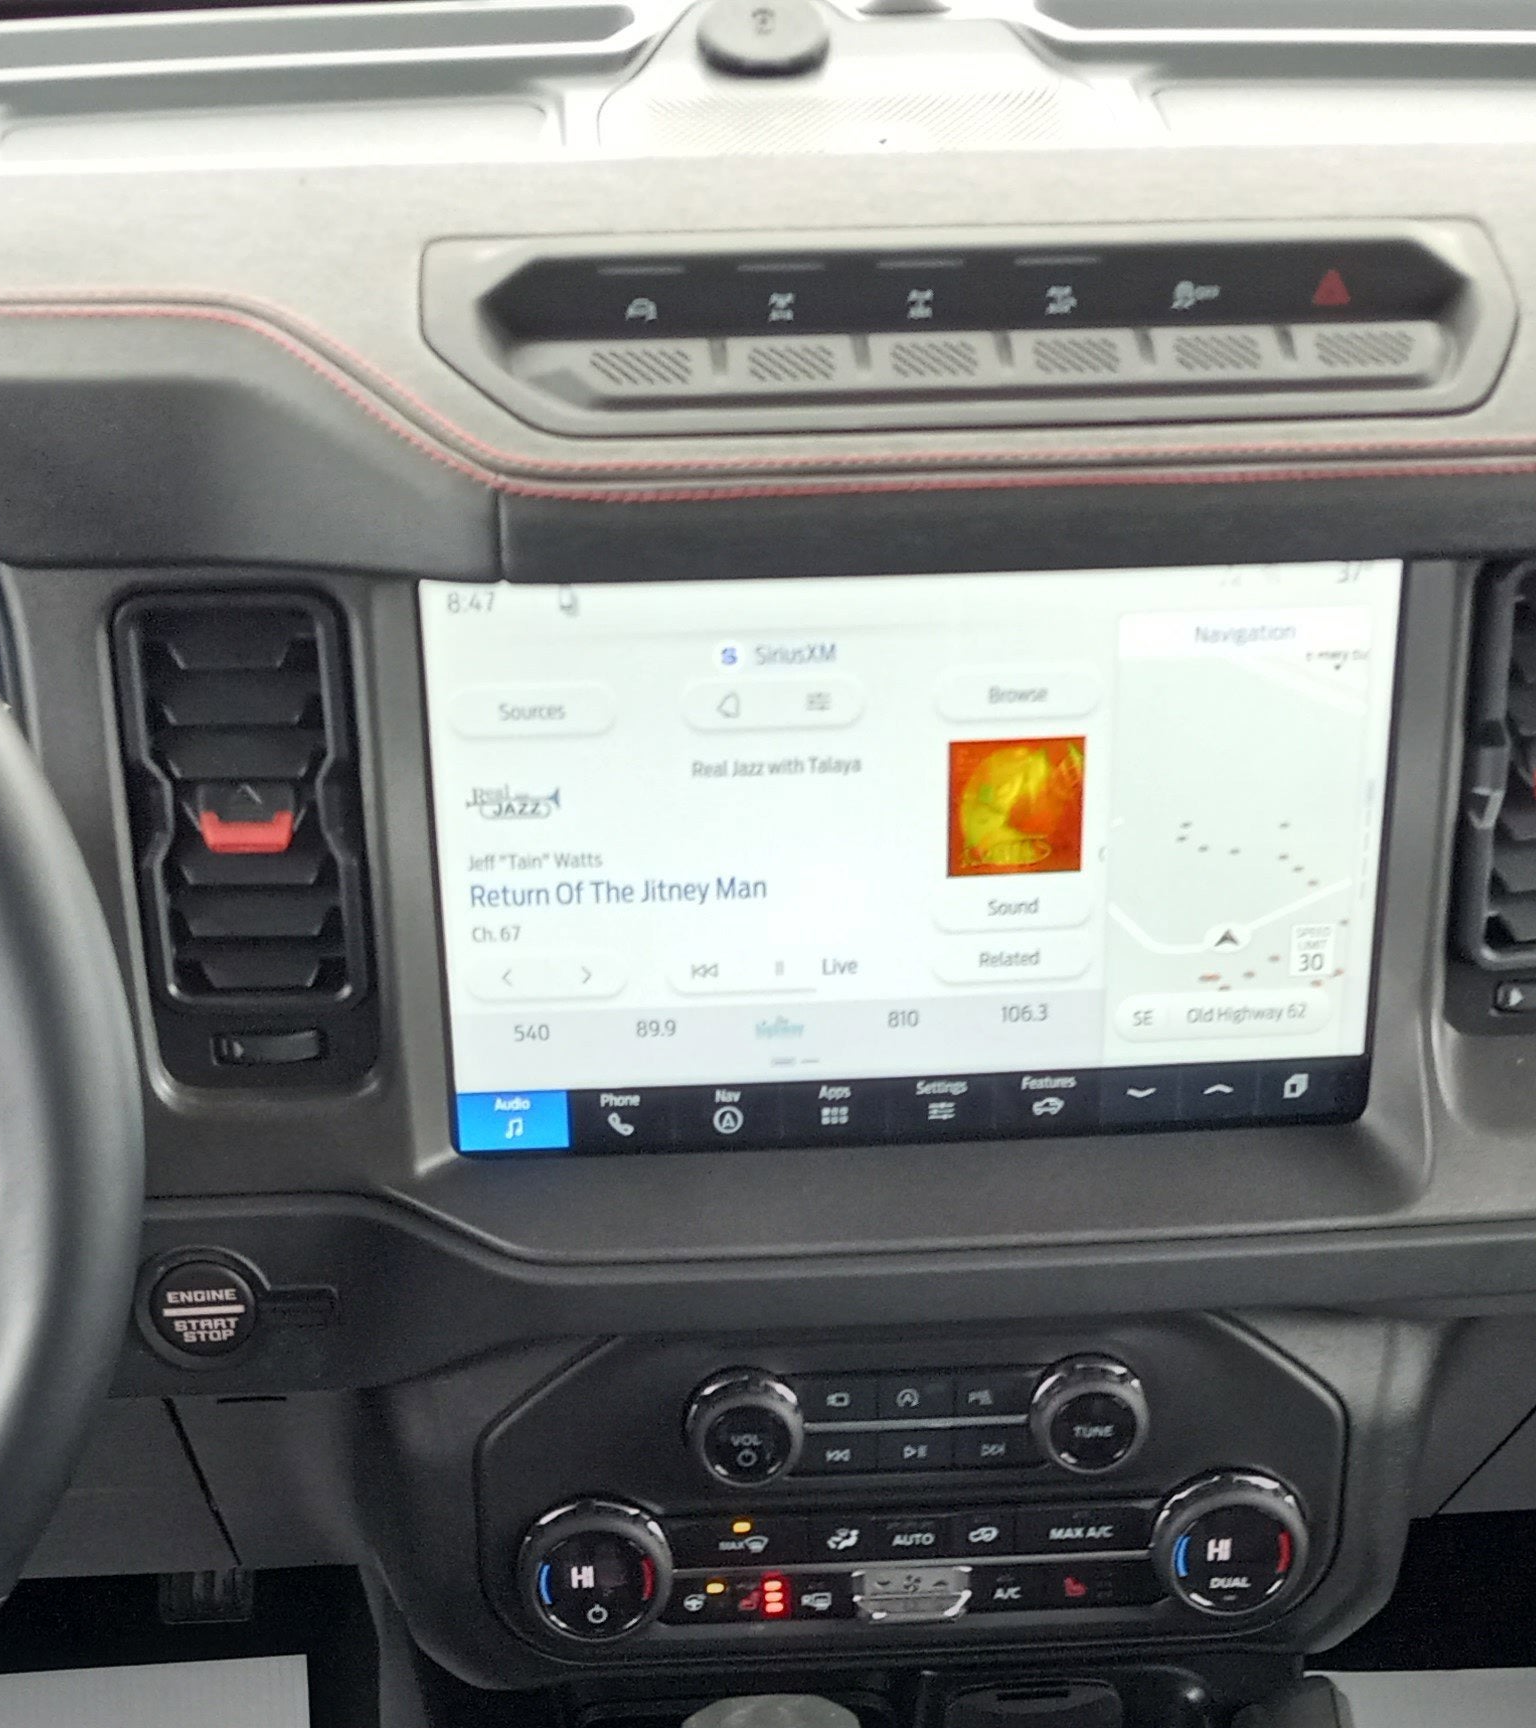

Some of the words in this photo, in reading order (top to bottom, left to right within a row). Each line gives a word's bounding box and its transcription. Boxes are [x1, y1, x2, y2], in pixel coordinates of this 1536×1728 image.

[1195, 625, 1297, 647] Navigation
[754, 643, 837, 667] SiriusXM
[987, 685, 1048, 705] Browse
[498, 702, 566, 722] Sources
[692, 759, 729, 779] Real
[731, 758, 764, 779] Jazz
[766, 757, 805, 777] with
[807, 755, 863, 778] Talaya
[493, 802, 542, 818] JAZZ
[467, 854, 496, 873] Jeff
[499, 852, 552, 872] "Tain"
[554, 851, 604, 870] Watts
[469, 883, 552, 907] Return
[555, 882, 586, 906] Of
[589, 880, 635, 904] The
[640, 877, 711, 910] Jitney
[715, 877, 768, 901] Man
[987, 897, 1039, 917] Sound
[471, 926, 498, 944] Ch.
[500, 924, 522, 943] 67
[821, 956, 859, 977] Live
[978, 950, 1041, 969] Related
[1298, 952, 1325, 973] 30
[887, 1010, 920, 1029] 810
[1000, 1003, 1049, 1025] 106.3
[1132, 1010, 1154, 1027] SE
[1186, 1006, 1215, 1025] Old
[1216, 1004, 1284, 1026] Highway
[1287, 1002, 1308, 1019] 62
[514, 1022, 552, 1043] 540
[636, 1018, 677, 1041] 89.9
[818, 1083, 853, 1102] Apps
[914, 1078, 968, 1098] Settings
[1020, 1075, 1077, 1093] Features
[493, 1095, 532, 1112] Audio
[599, 1091, 642, 1109] Phone
[715, 1088, 742, 1104] Nav
[166, 1288, 237, 1304] ENGINE
[173, 1317, 239, 1332] START
[183, 1329, 235, 1343] STOP
[730, 1434, 762, 1447] VOL
[1072, 1424, 1115, 1440] TUNE
[890, 1533, 936, 1547] AUTO
[1048, 1527, 1084, 1541] MAX
[1085, 1524, 1114, 1541] A/C
[1206, 1537, 1233, 1562] HI
[1209, 1575, 1252, 1590] DUAL
[992, 1585, 1021, 1602] A/C
